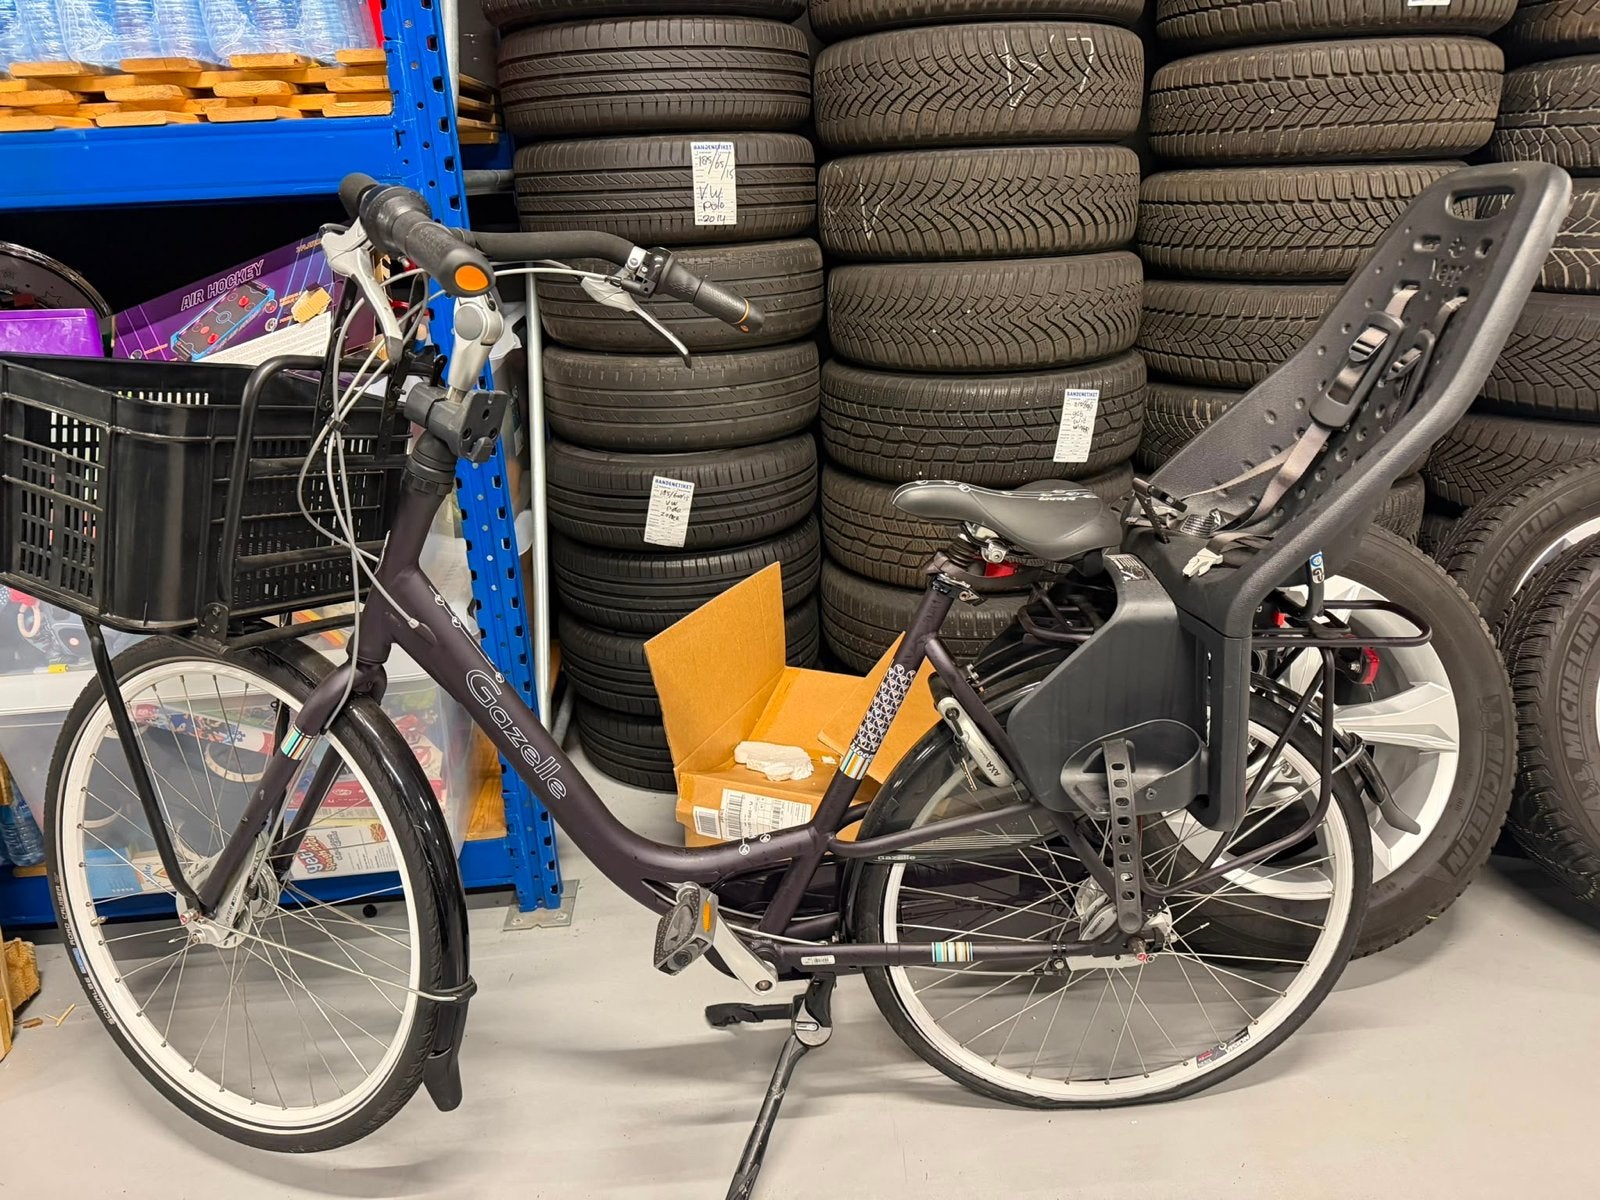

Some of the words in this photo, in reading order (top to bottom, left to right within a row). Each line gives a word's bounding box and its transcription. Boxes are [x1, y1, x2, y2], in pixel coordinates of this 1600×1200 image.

[181, 289, 204, 311] AIR
[207, 259, 264, 299] HOCKEY
[1559, 612, 1600, 760] MICHELIN
[466, 669, 567, 800] Gazelle
[986, 760, 1001, 777] AXA
[1445, 731, 1504, 877] MICHELIN
[65, 923, 75, 946] ROAD
[84, 977, 116, 1025] SCHWALBE
